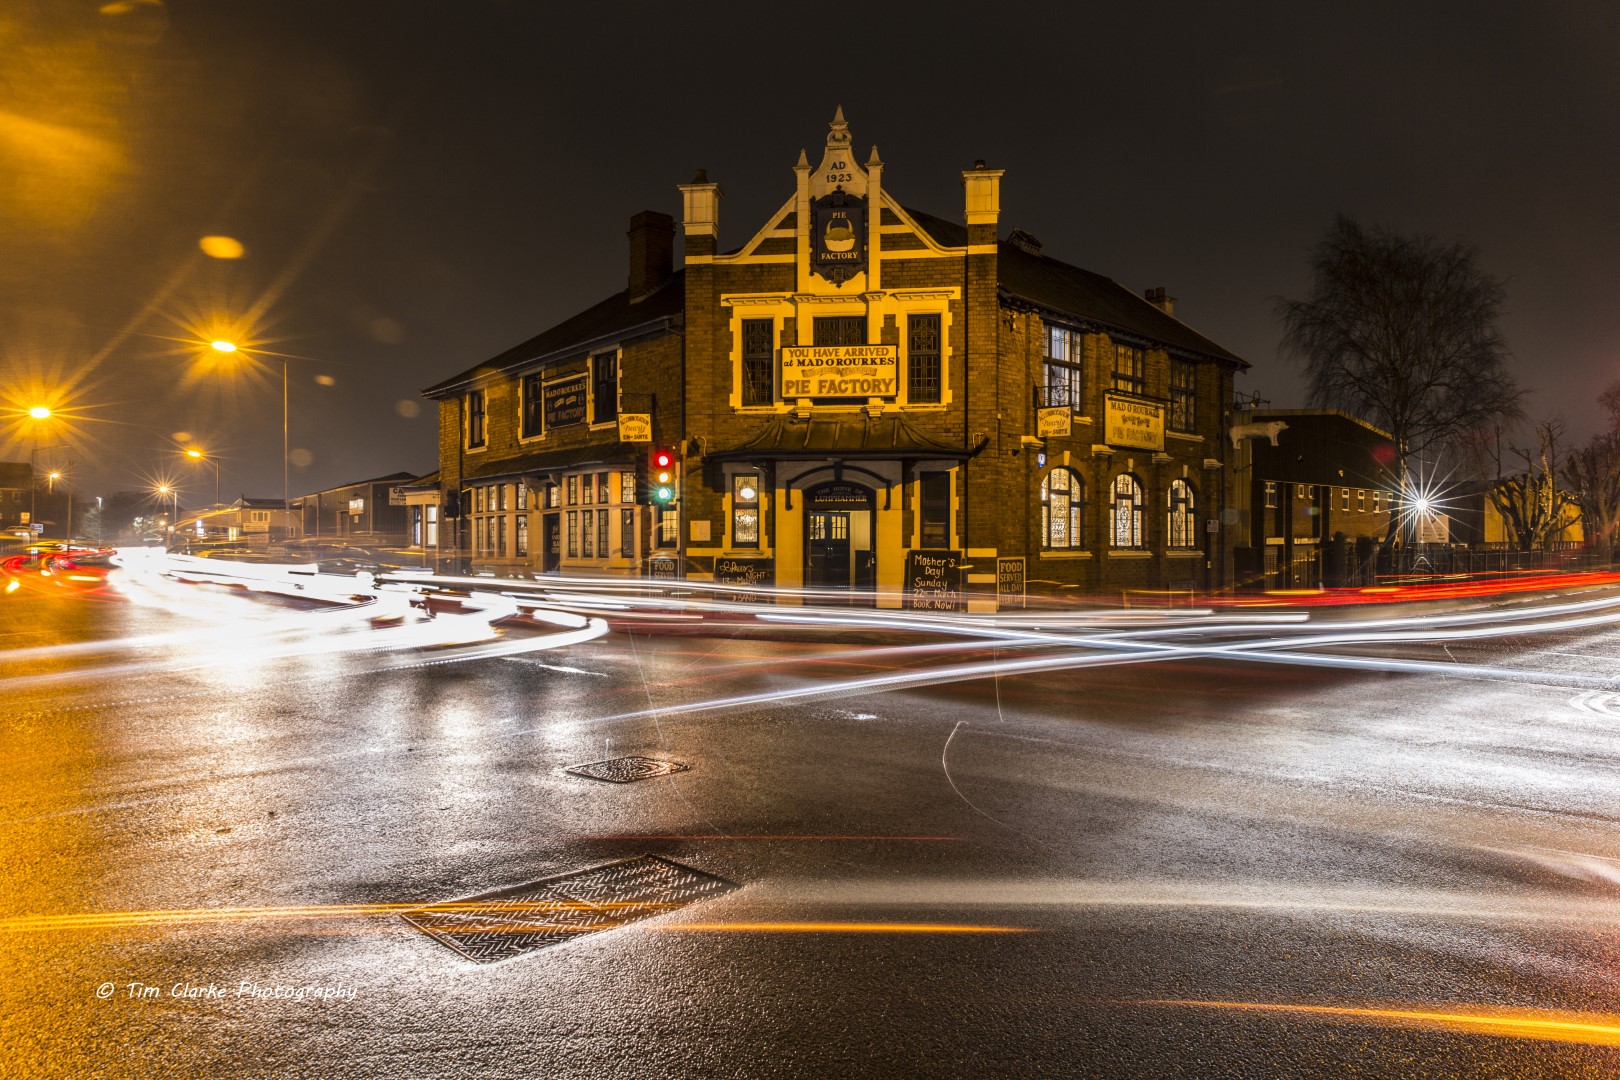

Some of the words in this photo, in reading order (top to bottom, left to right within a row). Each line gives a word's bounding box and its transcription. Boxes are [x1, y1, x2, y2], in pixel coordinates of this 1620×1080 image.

[830, 161, 846, 170] AD
[826, 173, 852, 183] 1923
[821, 251, 858, 260] FACTORY
[788, 349, 809, 358] YOU
[813, 348, 840, 357] HAVE
[843, 347, 889, 357] ARRIVED
[784, 359, 794, 367] at
[784, 379, 811, 395] PIE
[818, 378, 896, 394] FACTORY
[1111, 401, 1126, 412] MAD
[654, 561, 675, 571] FOOD
[914, 554, 956, 568] Mother's
[925, 566, 945, 579] Day!
[1000, 562, 1023, 573] FOOD
[1000, 573, 1022, 582] SERVED
[914, 576, 948, 591] Sunday
[1000, 583, 1010, 593] ALL
[1011, 582, 1022, 592] DAY
[933, 589, 957, 598] March
